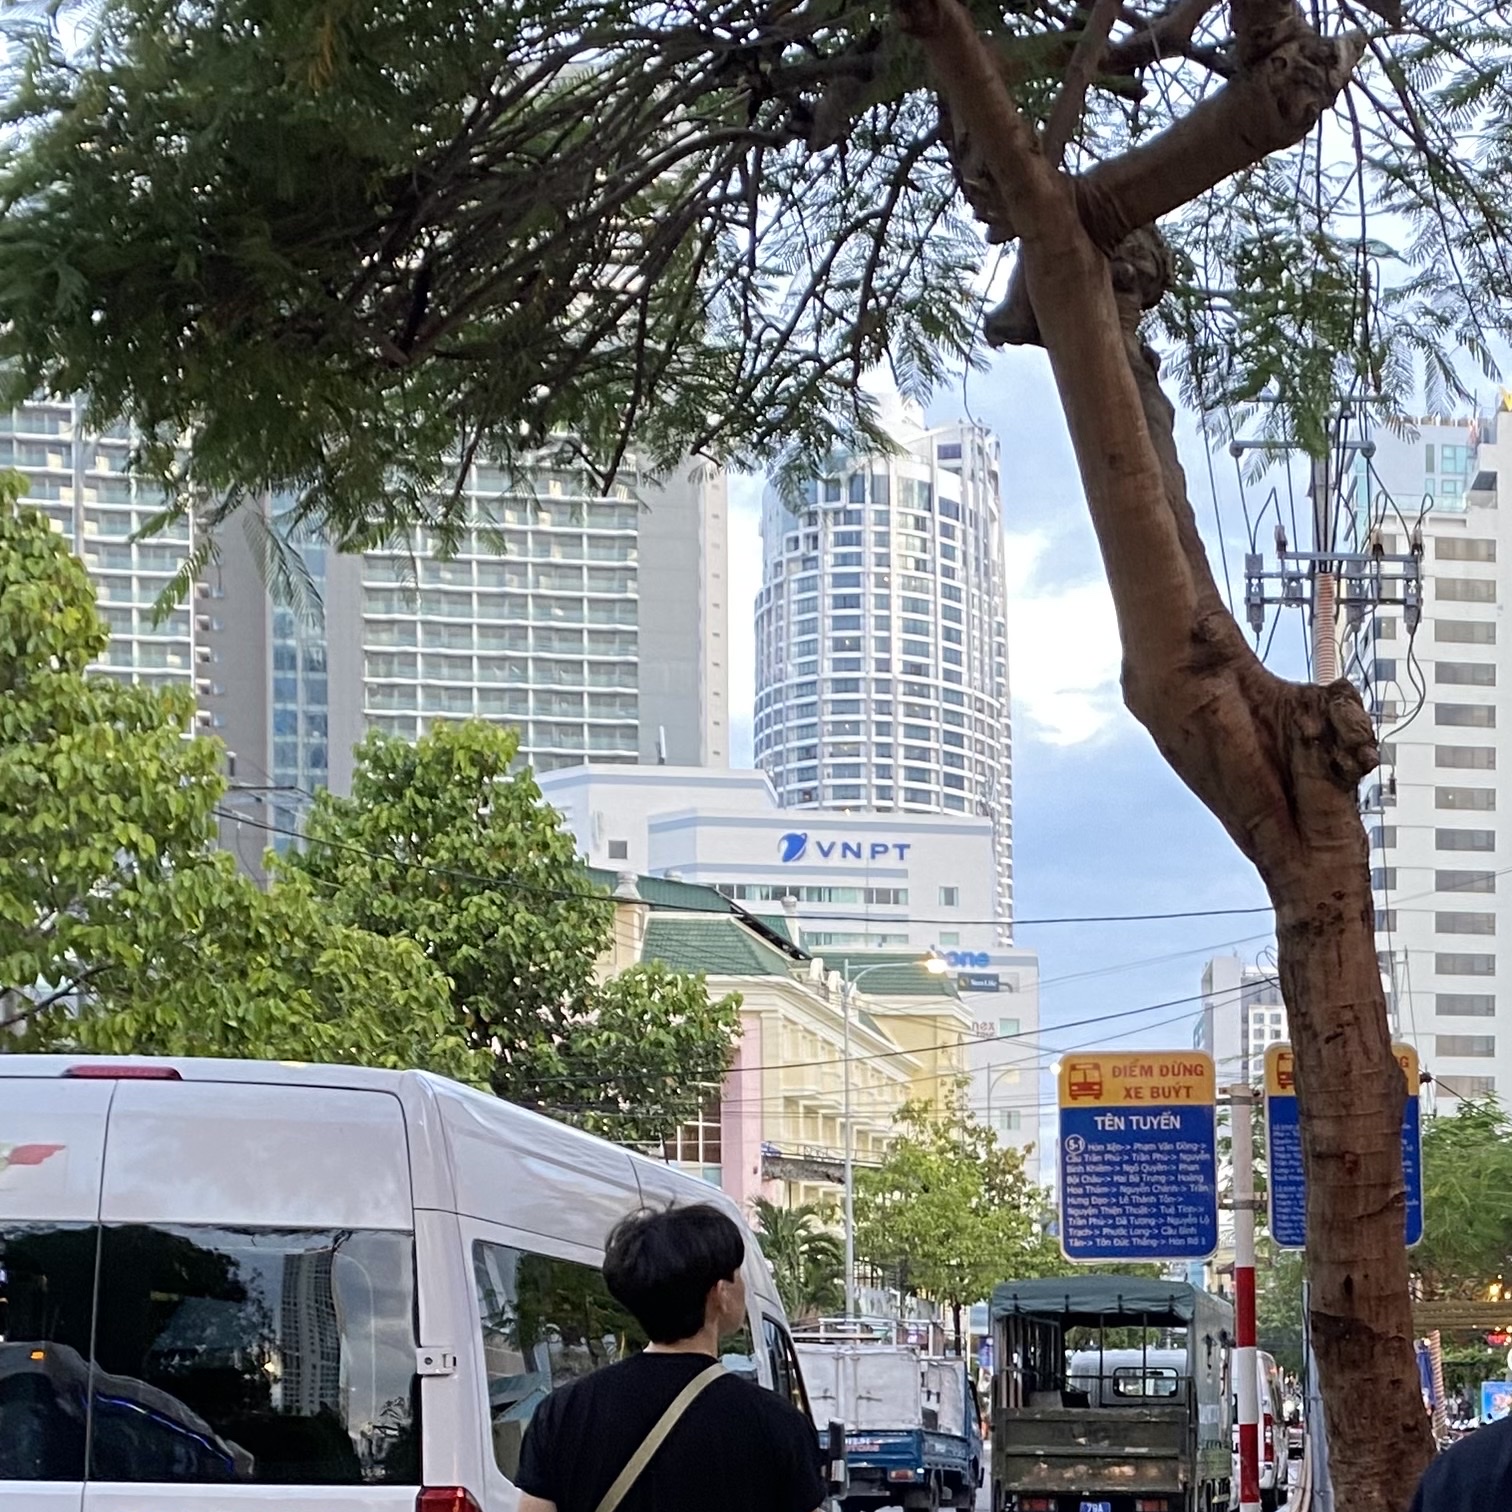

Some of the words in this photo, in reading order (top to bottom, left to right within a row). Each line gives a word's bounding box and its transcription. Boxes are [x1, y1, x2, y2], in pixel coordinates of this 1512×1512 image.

[815, 840, 911, 861] VNPT
[1123, 1086, 1144, 1100] XE
[1150, 1083, 1193, 1099] BUÝT
[1093, 1113, 1125, 1131] TÊN
[1129, 1111, 1181, 1130] TUYẾN
